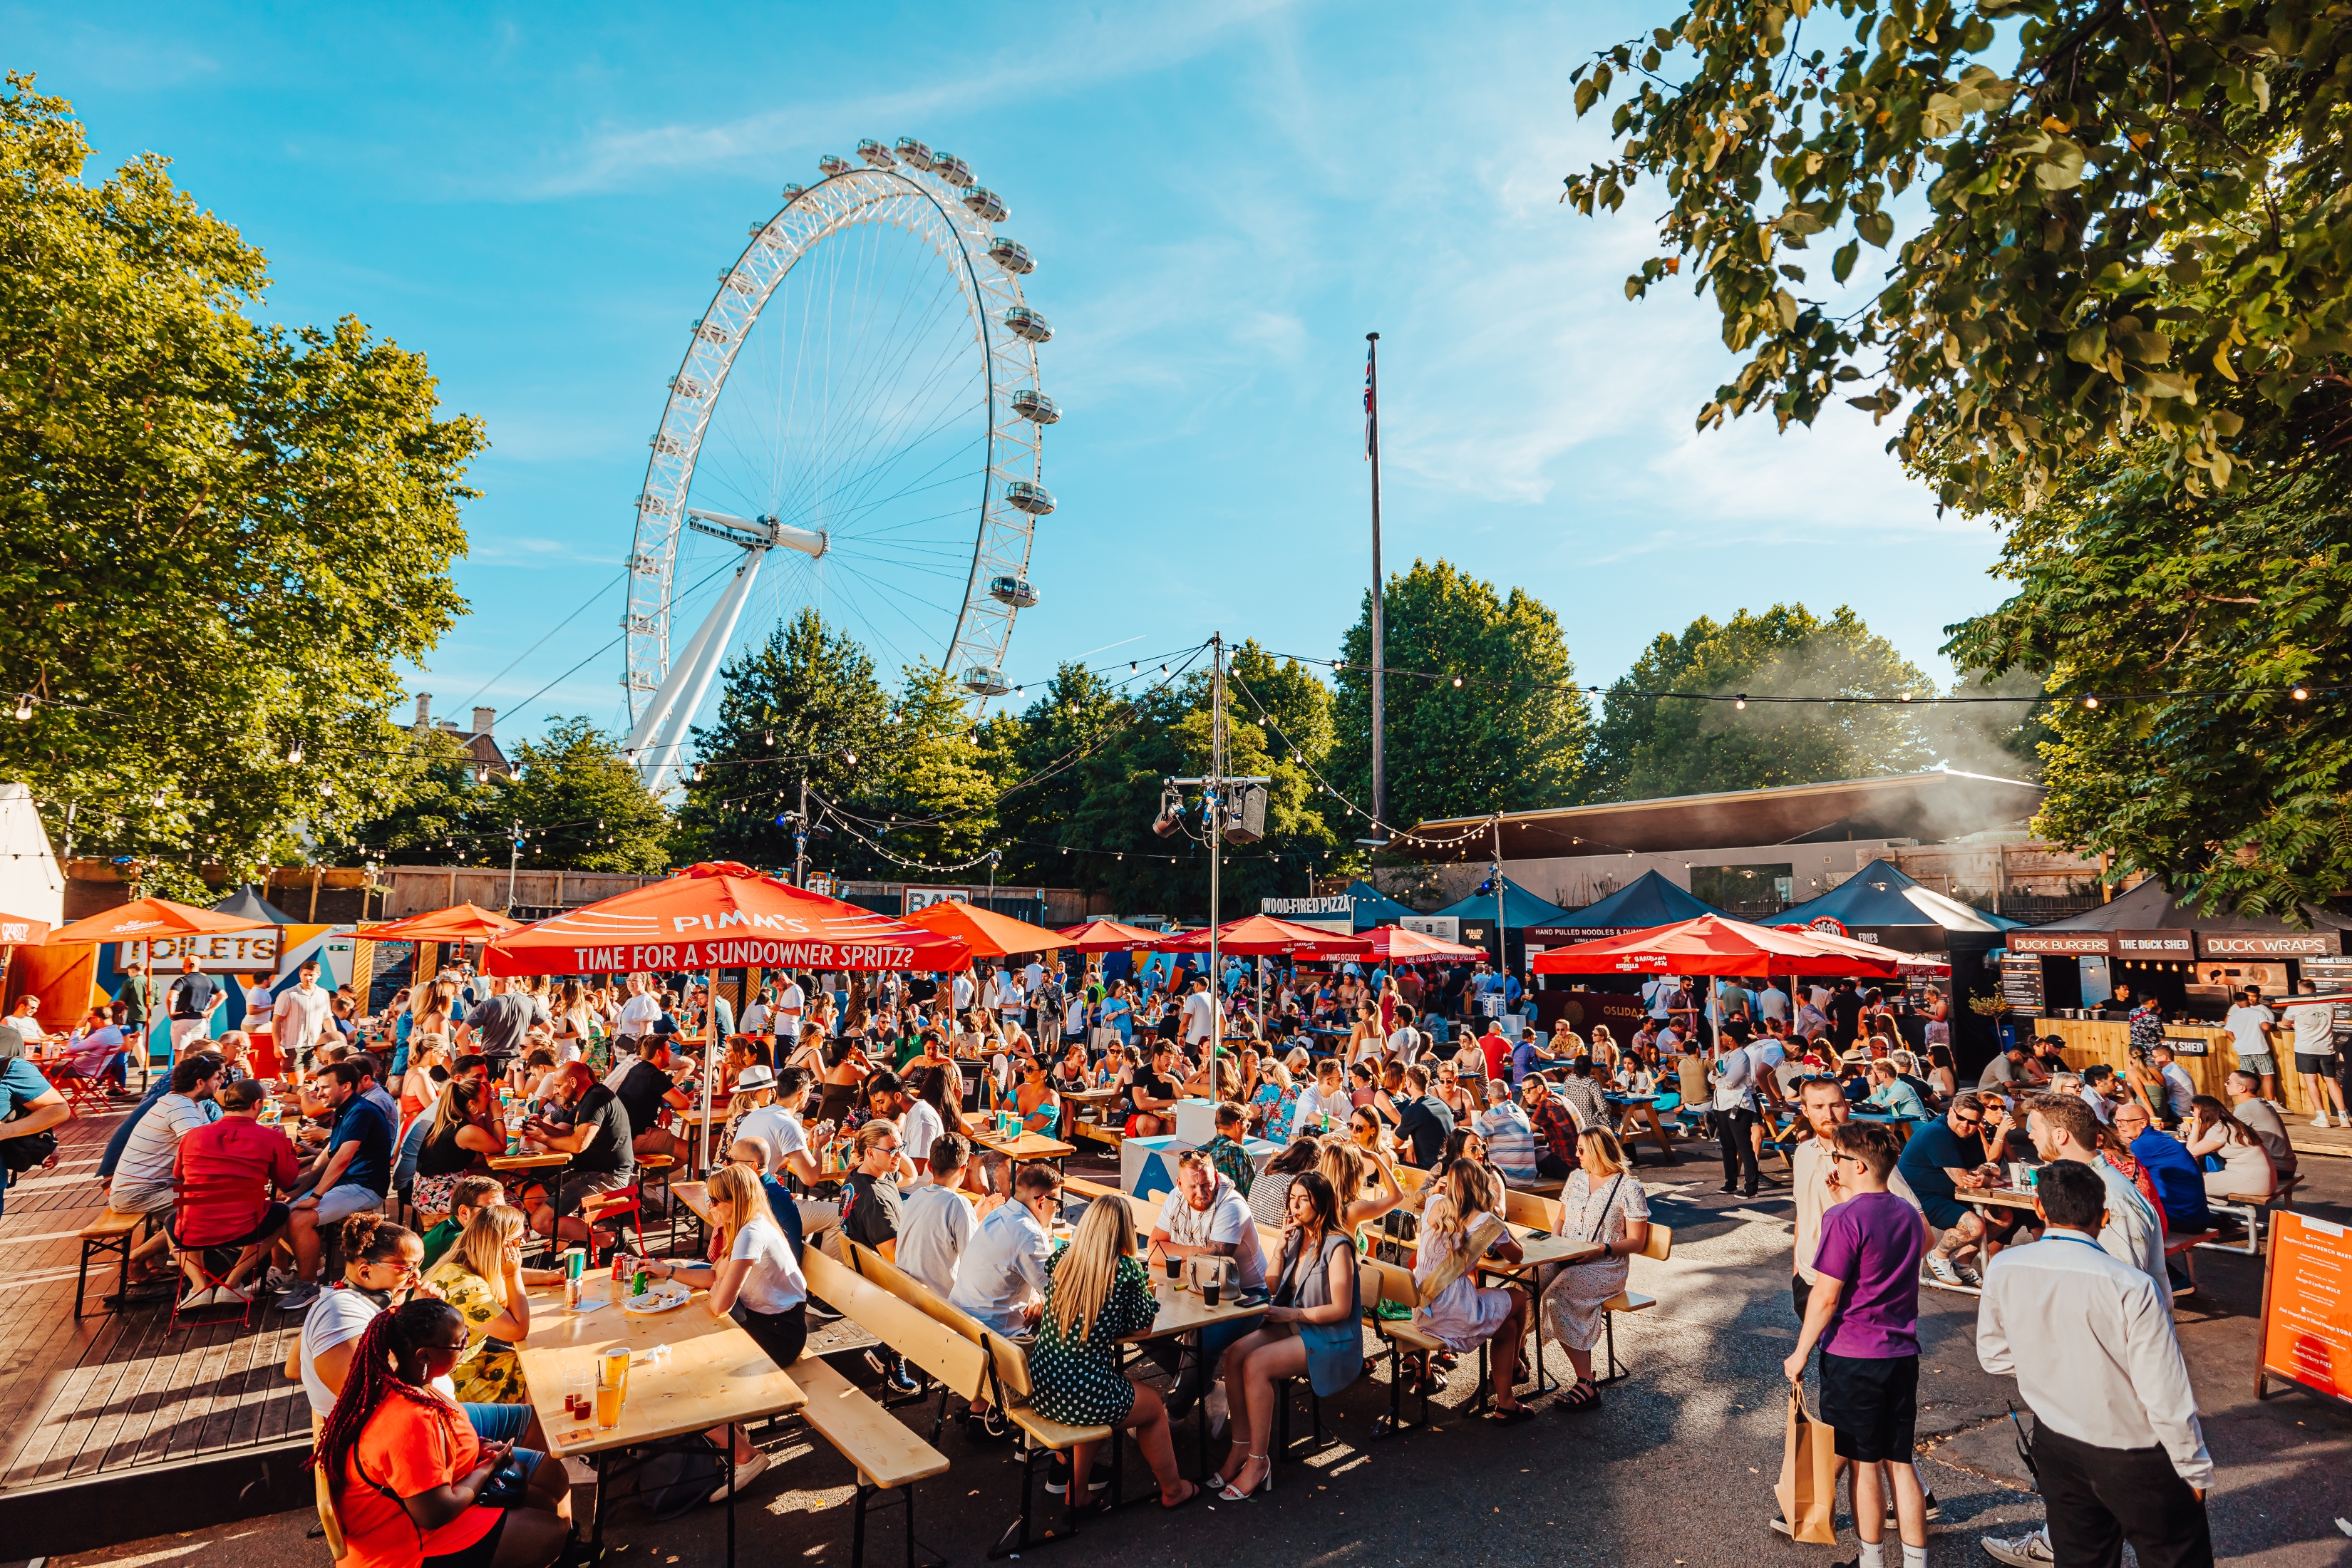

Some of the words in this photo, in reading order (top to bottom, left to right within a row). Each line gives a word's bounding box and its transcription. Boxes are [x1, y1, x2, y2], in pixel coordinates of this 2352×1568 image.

[1263, 897, 1319, 914] WOOD-FIRED
[1321, 895, 1351, 913] PIZZA
[673, 909, 810, 933] PIMM'S
[1858, 932, 1878, 944] FRIES
[2119, 939, 2137, 950] THE
[2139, 939, 2163, 950] DUCK
[2164, 939, 2189, 950] SHED
[131, 937, 276, 959] TOILETS
[2015, 939, 2048, 949] DUCK
[2051, 940, 2108, 951] BURGERS
[2209, 939, 2256, 952] DUCK
[2261, 939, 2326, 952] WRAPS
[574, 947, 625, 971] TIME
[633, 945, 676, 969] FOR
[684, 944, 699, 966] A
[706, 941, 834, 966] SUNDOWNER
[839, 945, 914, 968] SPRITZ?
[1431, 953, 1458, 961] SUNDOWNER
[2178, 1041, 2204, 1053] SHED
[2312, 1224, 2335, 1235] COCKTAILS
[2284, 1236, 2302, 1246] Raspberry
[2314, 1244, 2336, 1255] FRENCH
[2295, 1276, 2308, 1284] Mango
[2326, 1285, 2341, 1294] MULE
[2321, 1320, 2336, 1331] Orange
[2336, 1327, 2352, 1337] SODA
[2320, 1360, 2332, 1369] FIZZ
